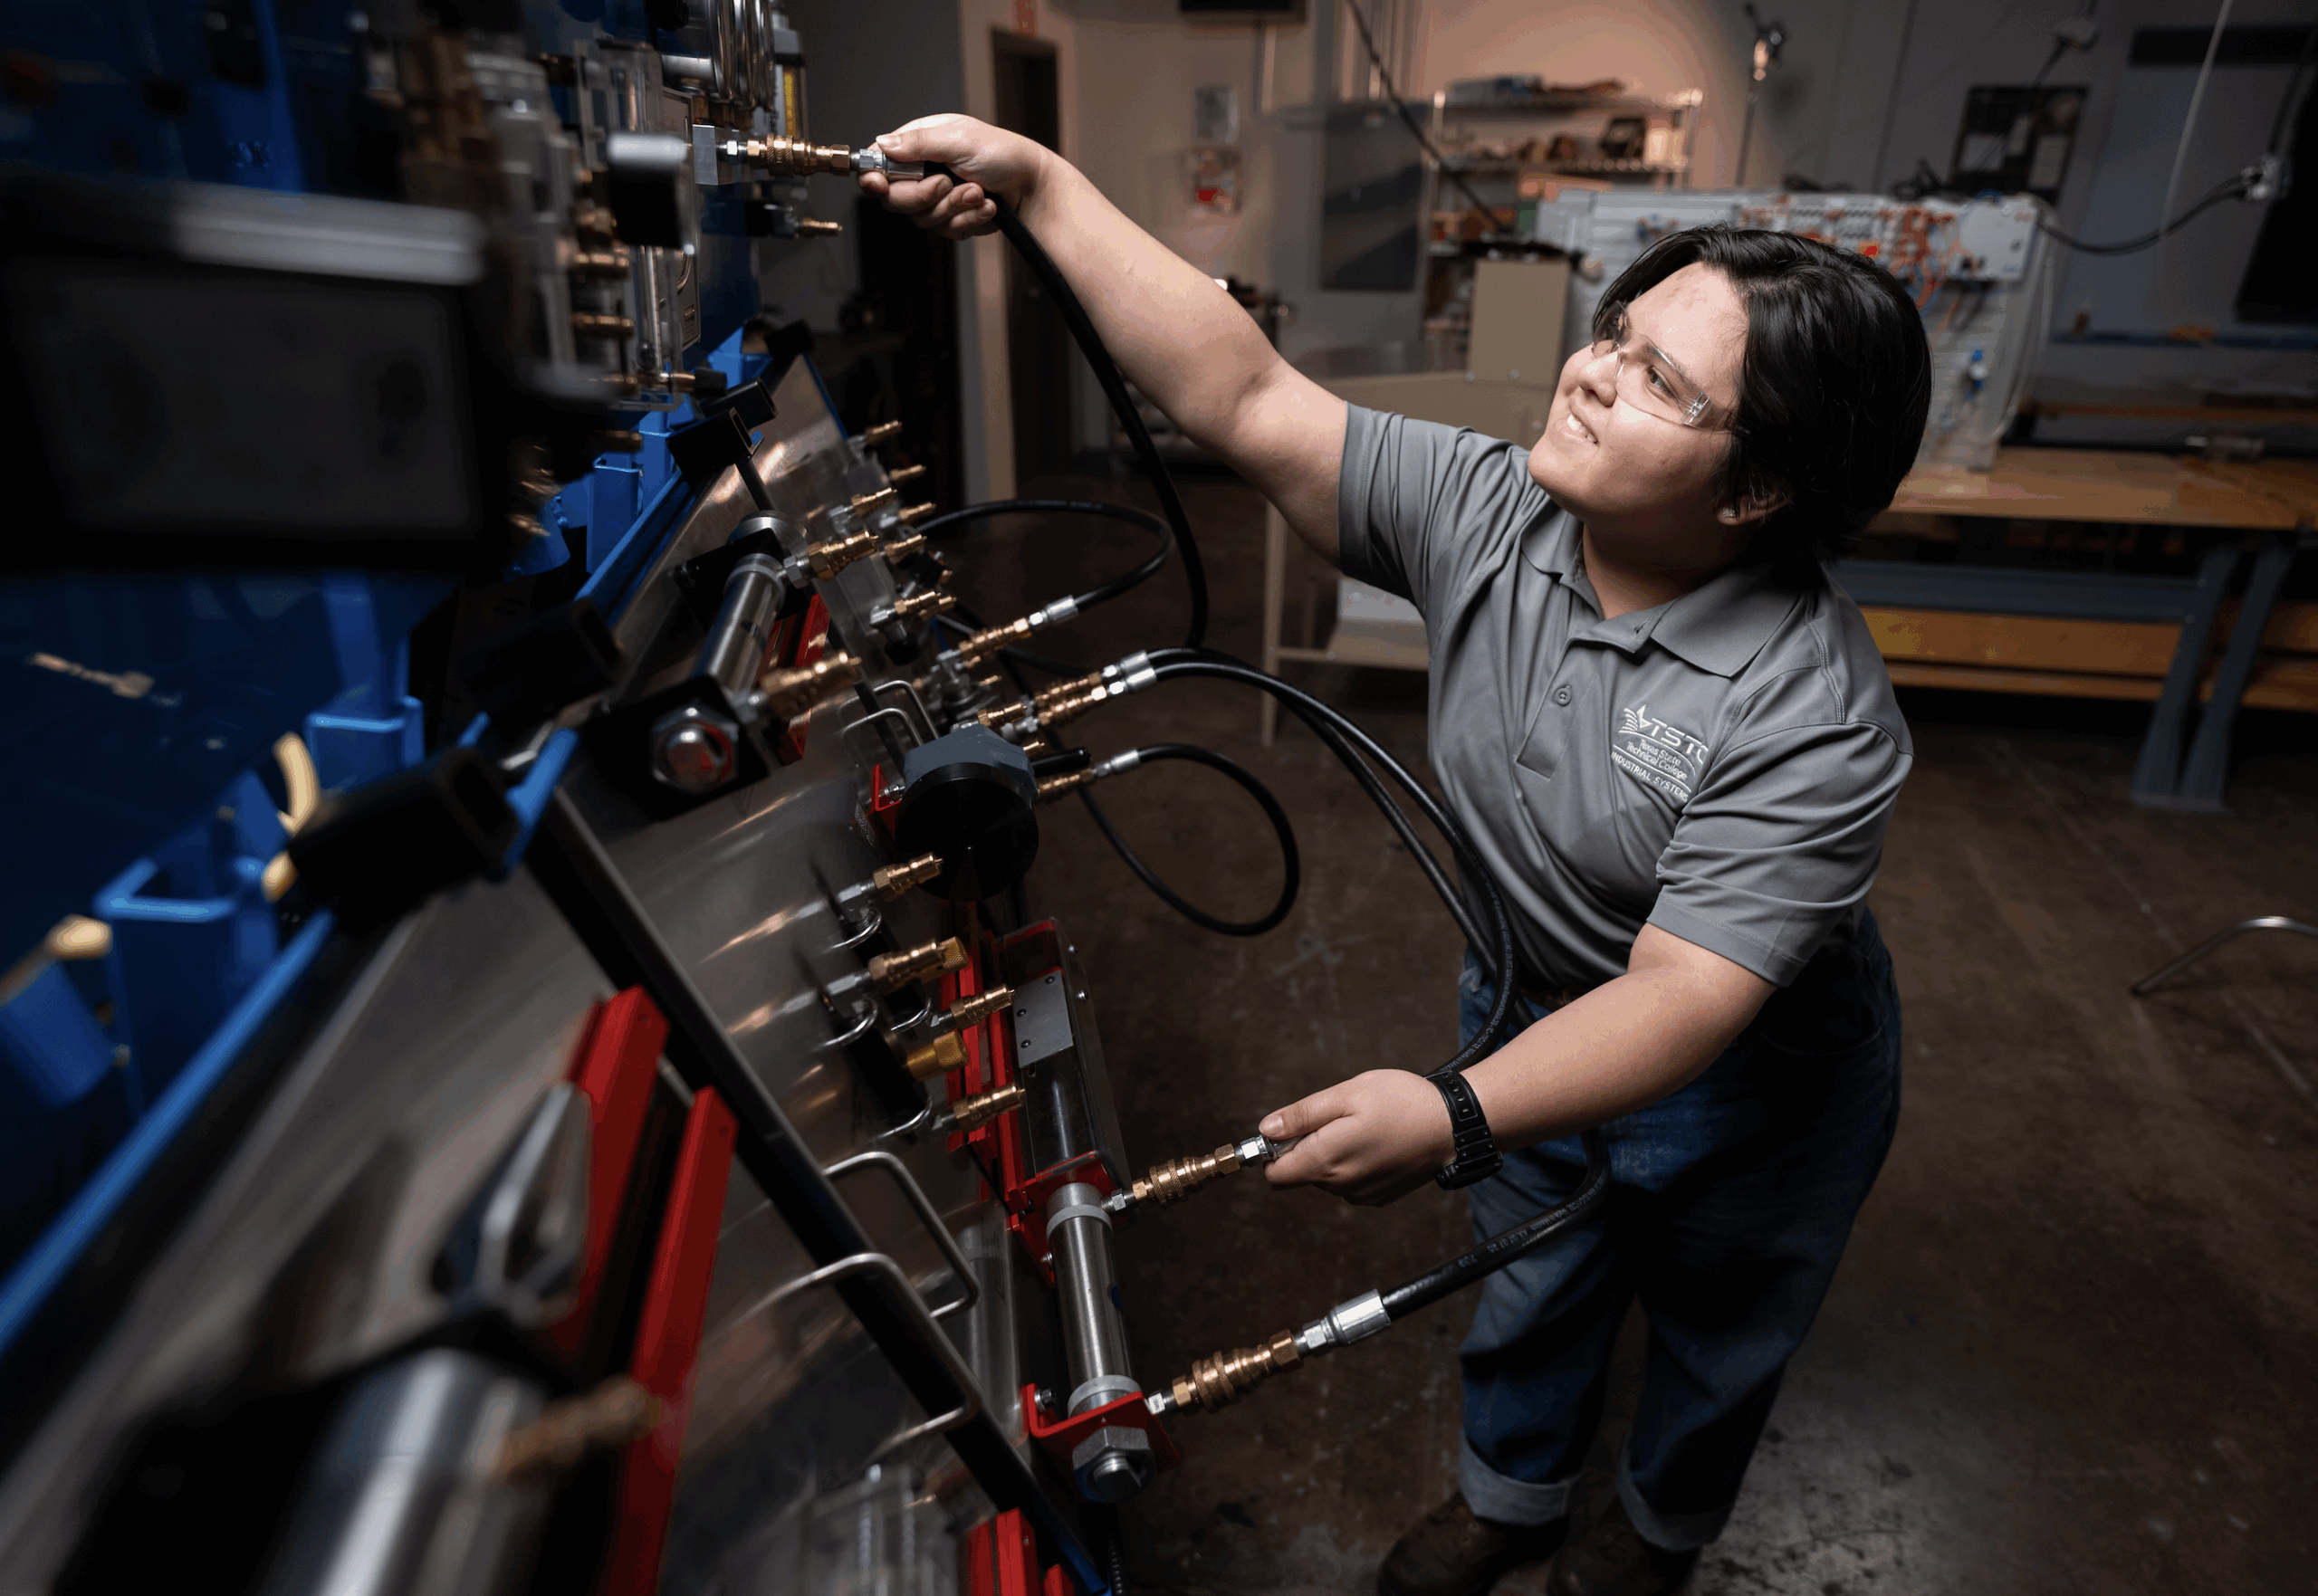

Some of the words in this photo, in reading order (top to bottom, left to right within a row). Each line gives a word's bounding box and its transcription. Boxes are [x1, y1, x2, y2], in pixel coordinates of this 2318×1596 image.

[1626, 741, 1659, 766] Technical
[1658, 760, 1688, 780] College
[1640, 738, 1660, 756] Texas
[1658, 749, 1681, 766] State
[1610, 750, 1652, 781] INDUSTRIAL
[1652, 776, 1689, 803] SYSTEMS
